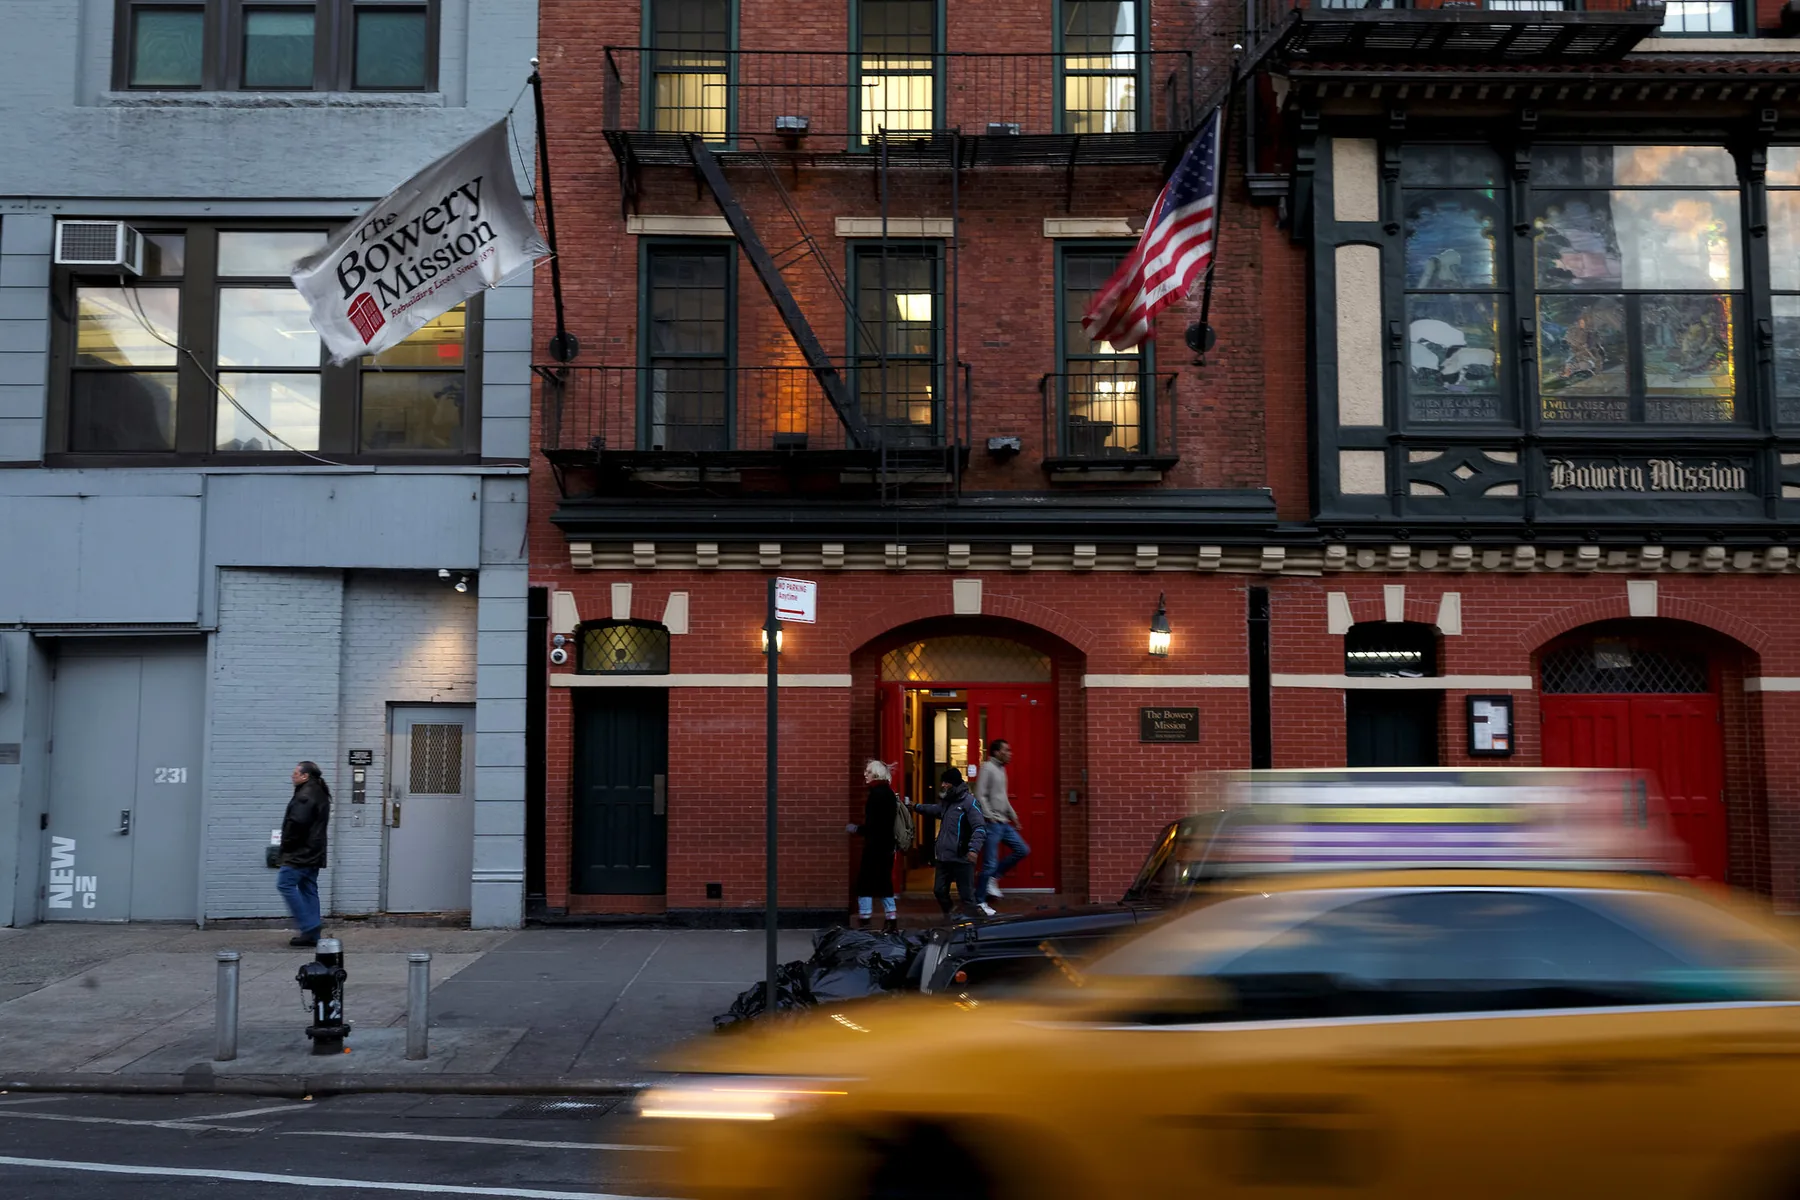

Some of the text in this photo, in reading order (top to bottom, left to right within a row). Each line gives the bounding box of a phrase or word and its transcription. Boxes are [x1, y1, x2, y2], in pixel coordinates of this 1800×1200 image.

[336, 175, 484, 300] Bowery
[355, 212, 398, 246] The
[373, 220, 498, 310] Mission
[391, 286, 434, 318] Rebuilding
[433, 273, 455, 290] Lives
[455, 260, 479, 277] Since
[1542, 410, 1557, 420] GO
[1557, 410, 1572, 420] TO
[1573, 410, 1589, 421] MY
[1548, 400, 1575, 410] WILL
[1576, 401, 1606, 411] ARISE
[1606, 401, 1628, 411] AND
[1549, 459, 1745, 492] Bowery Mission
[778, 582, 807, 593] NO PARKING
[1145, 710, 1194, 721] The Bowery
[1154, 721, 1186, 729] Mission
[154, 767, 188, 783] 231
[48, 836, 76, 909] NEW
